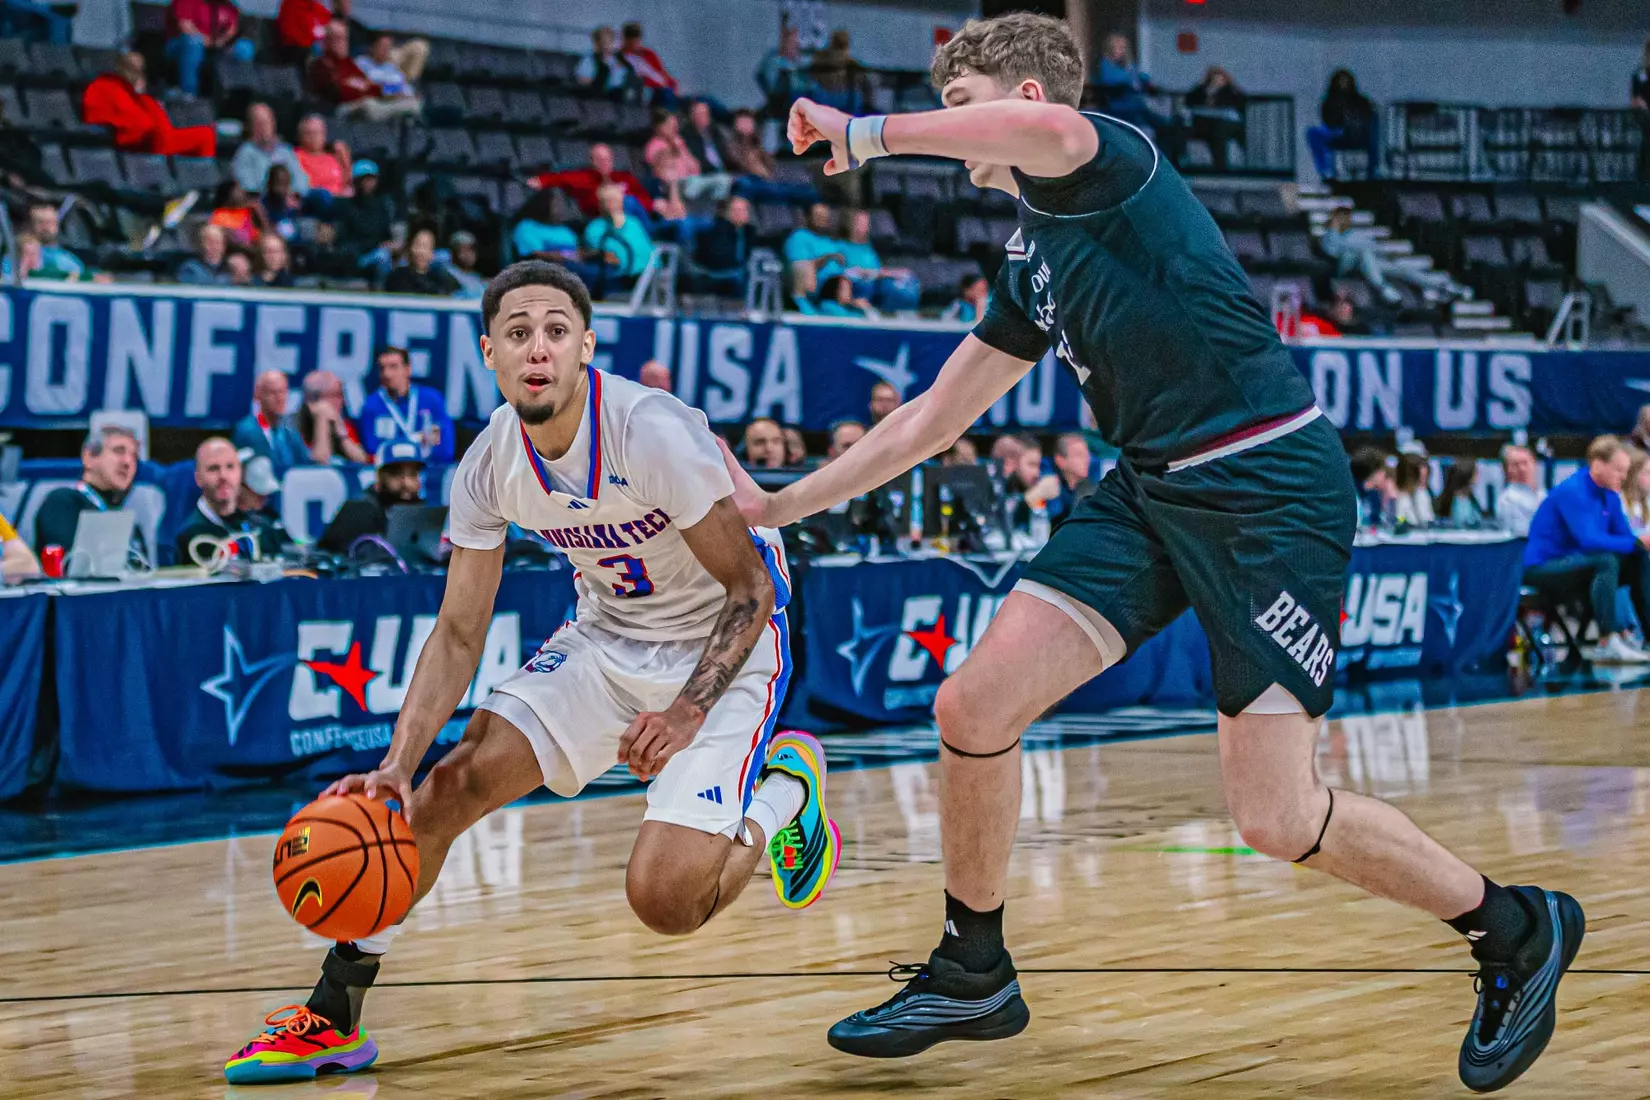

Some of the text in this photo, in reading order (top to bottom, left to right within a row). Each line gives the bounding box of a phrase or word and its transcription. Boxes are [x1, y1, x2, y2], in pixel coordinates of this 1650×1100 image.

[0, 292, 619, 419] ONFEREN
[653, 320, 802, 423] USA
[1312, 351, 1402, 429] ON
[1434, 351, 1532, 430] US
[540, 523, 631, 548] OUISIANA
[597, 554, 655, 598] 3
[1255, 590, 1333, 688] BEARS
[1340, 571, 1428, 647] USA
[288, 611, 521, 721] CUA
